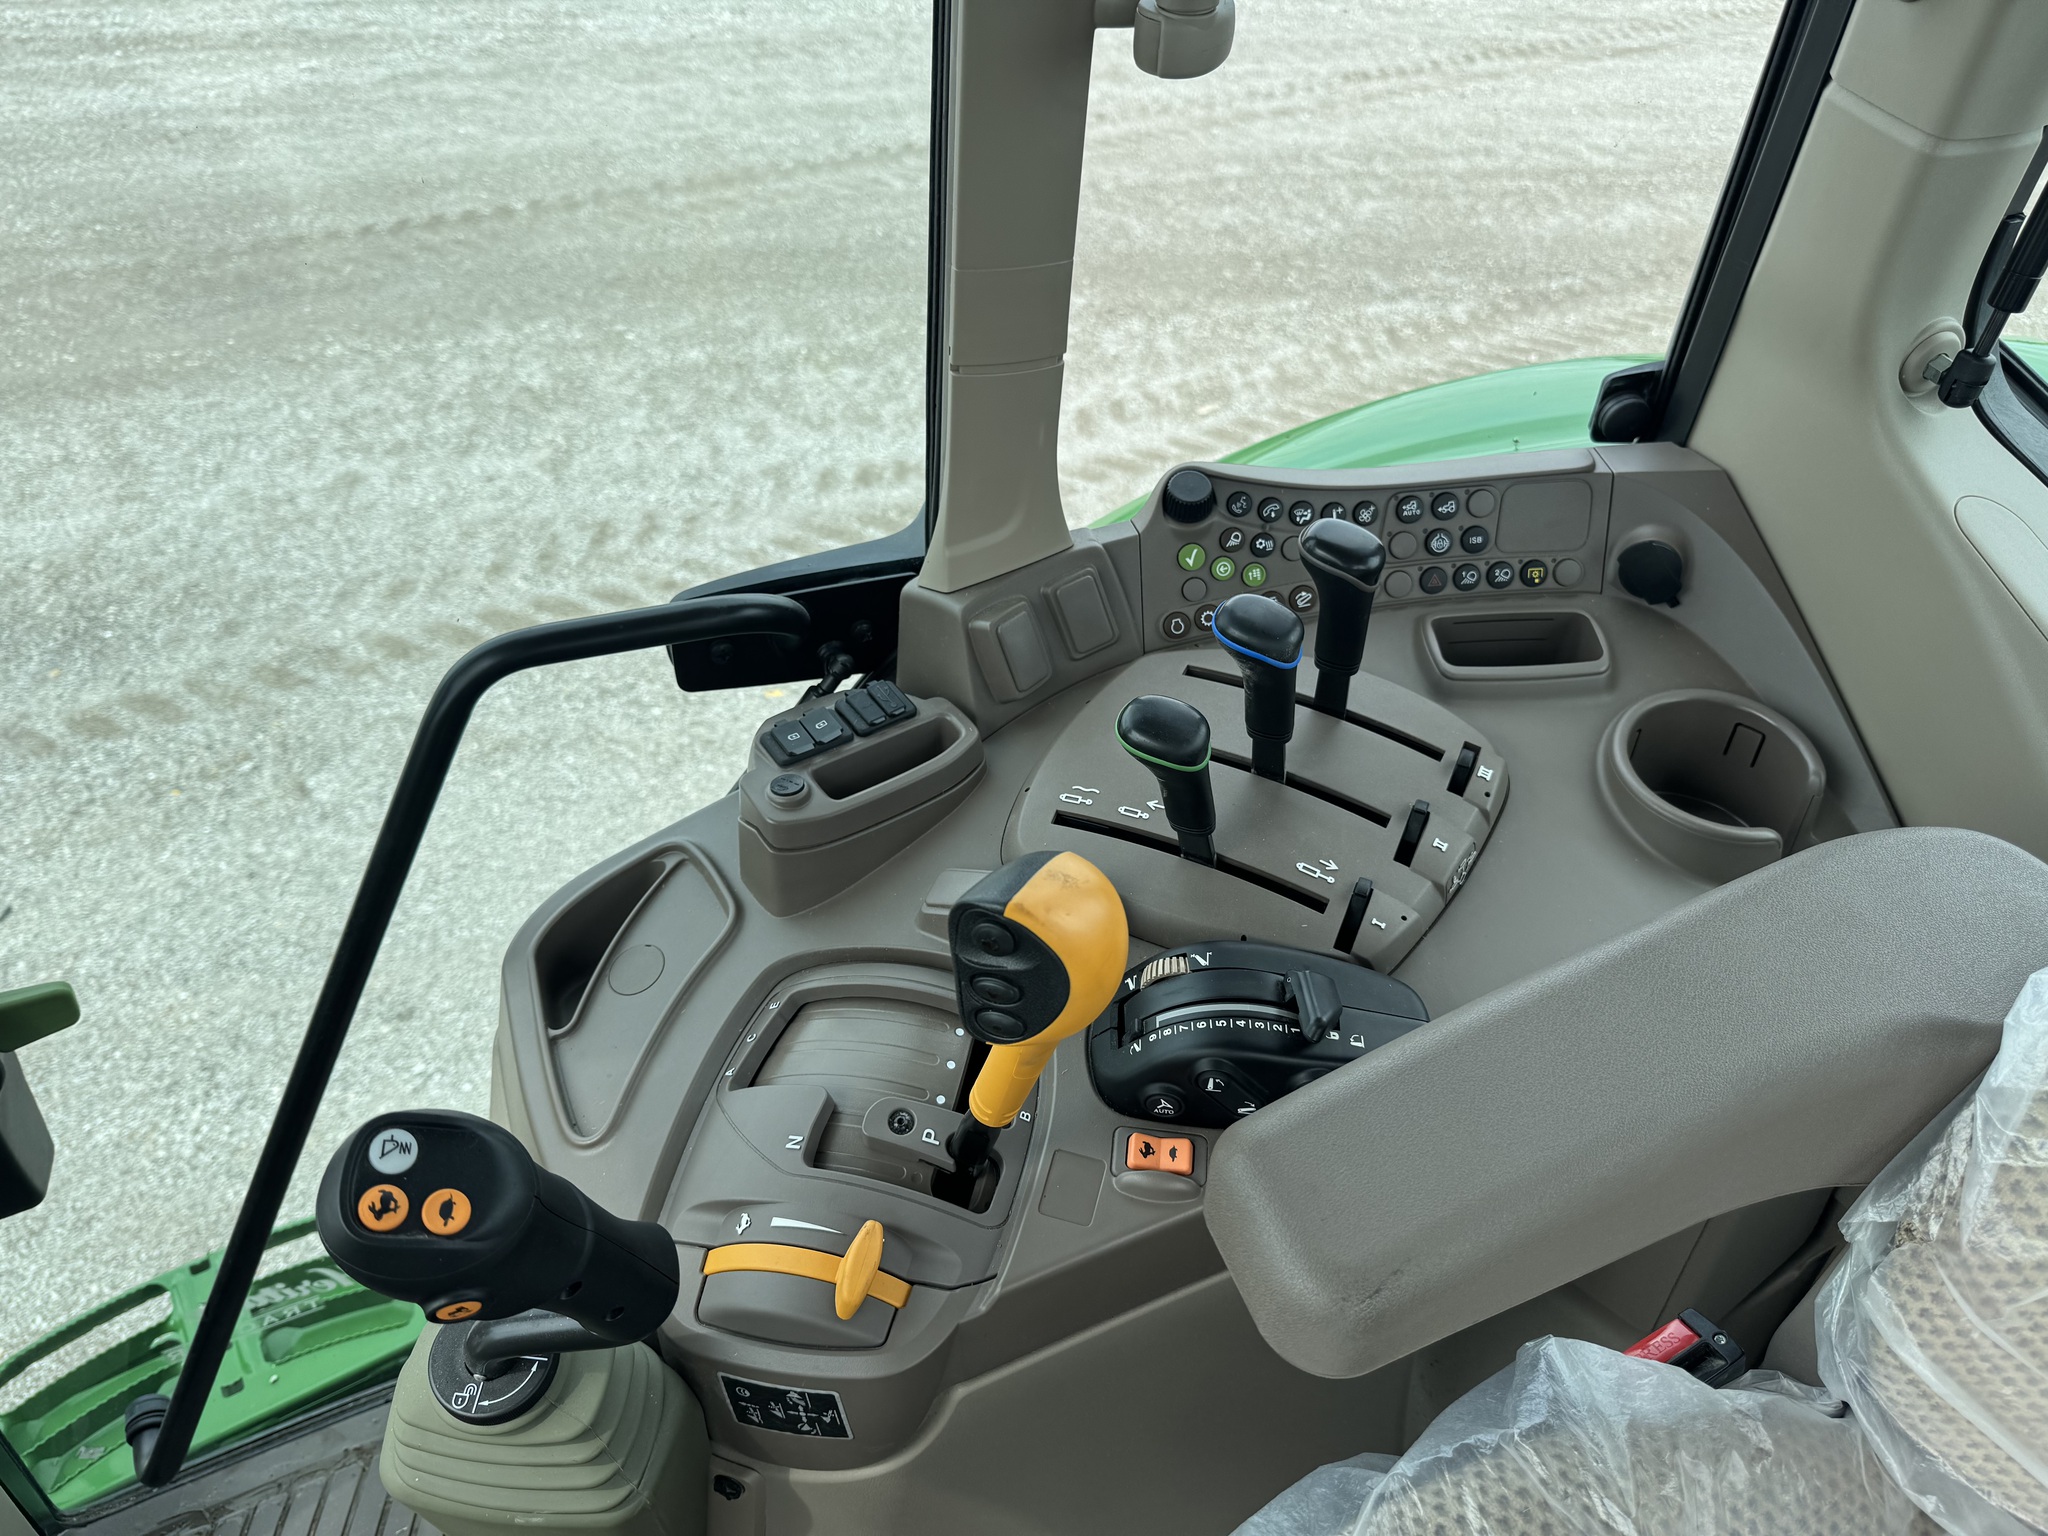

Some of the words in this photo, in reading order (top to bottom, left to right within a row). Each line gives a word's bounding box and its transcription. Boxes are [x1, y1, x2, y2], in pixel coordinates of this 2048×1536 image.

[1477, 765, 1494, 782] III
[1432, 837, 1448, 852] II
[1371, 918, 1387, 930] I
[769, 1001, 781, 1010] E
[1148, 1033, 1157, 1042] 9
[1162, 1028, 1172, 1037] 8
[1196, 1021, 1207, 1029] 6
[1235, 1019, 1246, 1028] 4
[1272, 1024, 1283, 1032] 2
[746, 1033, 757, 1042] C
[725, 1067, 736, 1076] A
[1019, 1110, 1031, 1122] B
[785, 1134, 805, 1150] N
[922, 1128, 940, 1146] P
